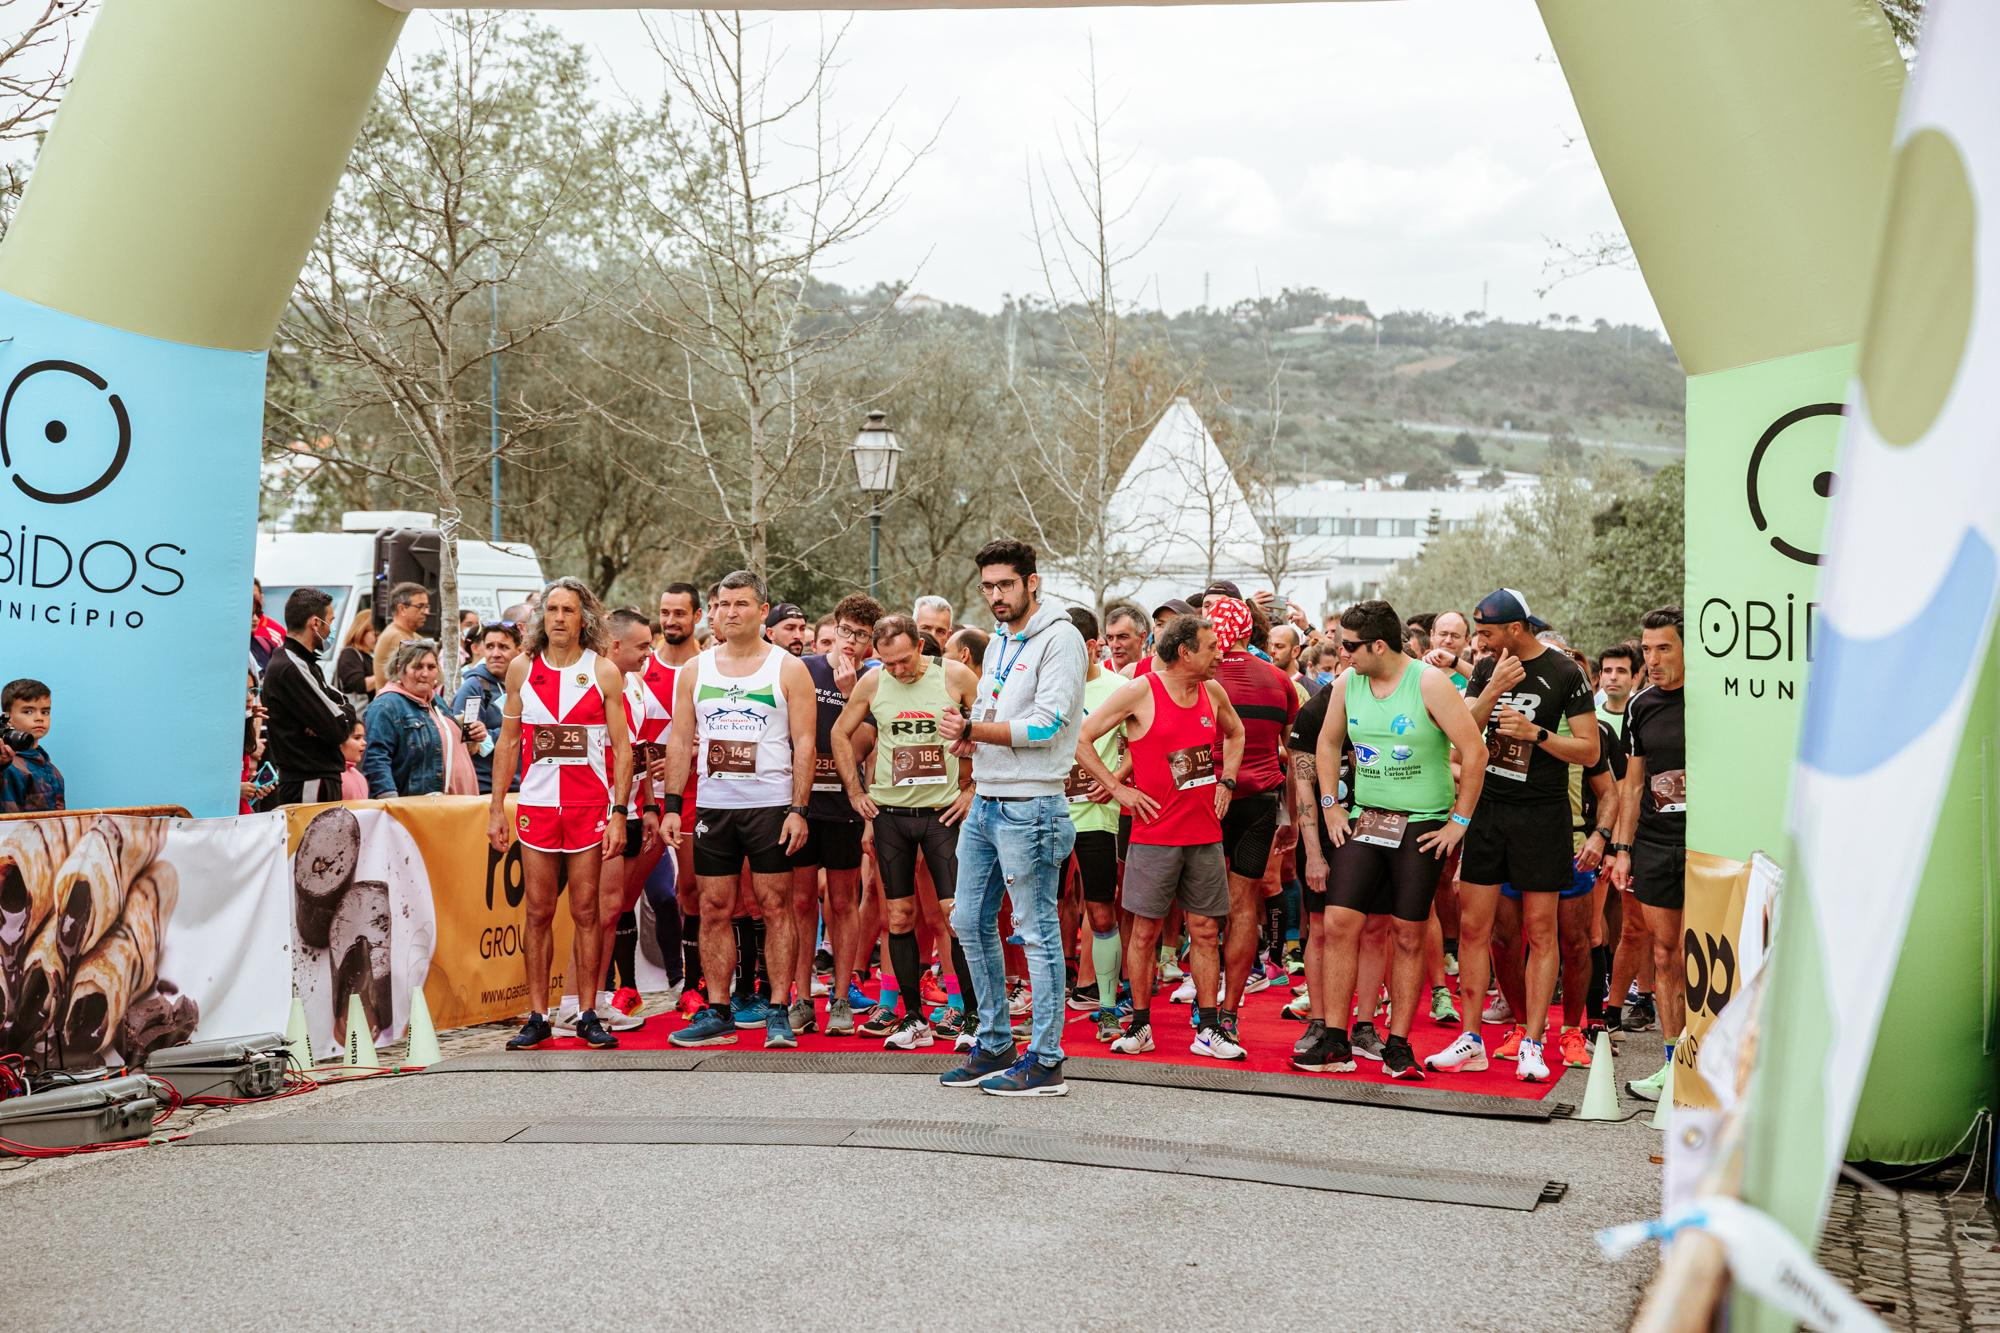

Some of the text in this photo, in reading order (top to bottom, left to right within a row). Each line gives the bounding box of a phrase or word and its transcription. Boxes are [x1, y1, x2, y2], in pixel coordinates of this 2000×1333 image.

[0, 601, 144, 629] NICÍPIO
[1724, 676, 1811, 700] MUN
[826, 697, 845, 706] ÓBIDO
[708, 723, 729, 731] Kate
[731, 723, 755, 731] Kero
[891, 720, 937, 736] RB
[563, 731, 580, 743] 26
[730, 746, 751, 758] 145
[1508, 743, 1522, 757] 51
[919, 751, 940, 762] 186
[1078, 769, 1091, 780] 6
[1383, 813, 1400, 825] 25
[479, 924, 527, 960] GROU
